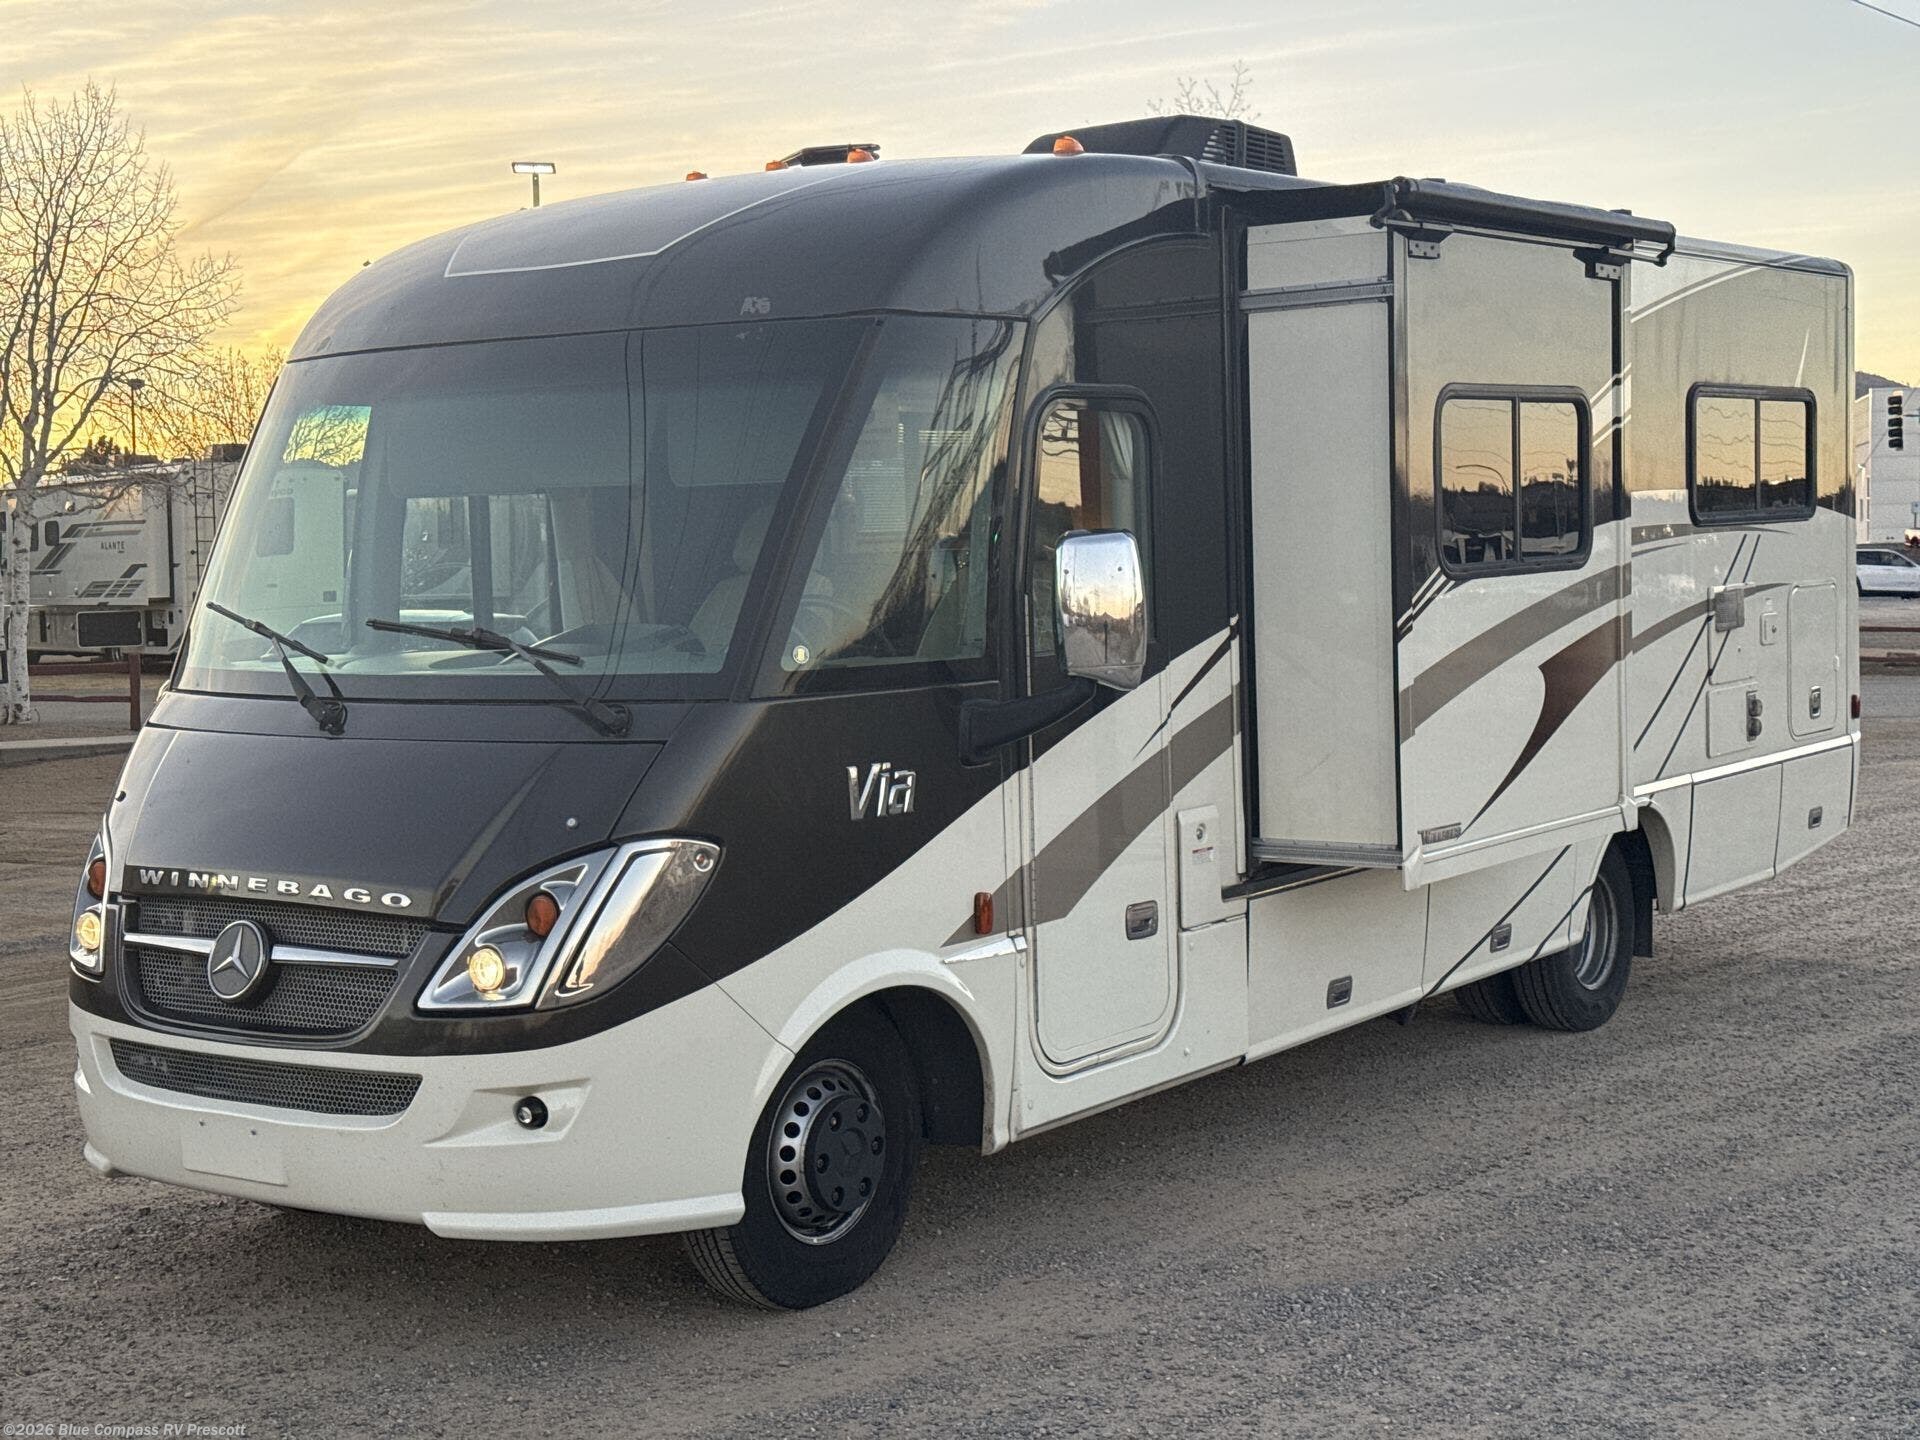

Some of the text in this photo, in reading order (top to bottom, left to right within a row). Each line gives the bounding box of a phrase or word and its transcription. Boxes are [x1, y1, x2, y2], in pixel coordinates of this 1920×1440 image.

[100, 540, 125, 550] ALANTE
[845, 761, 916, 821] Via
[138, 868, 413, 909] WINNEBAGO
